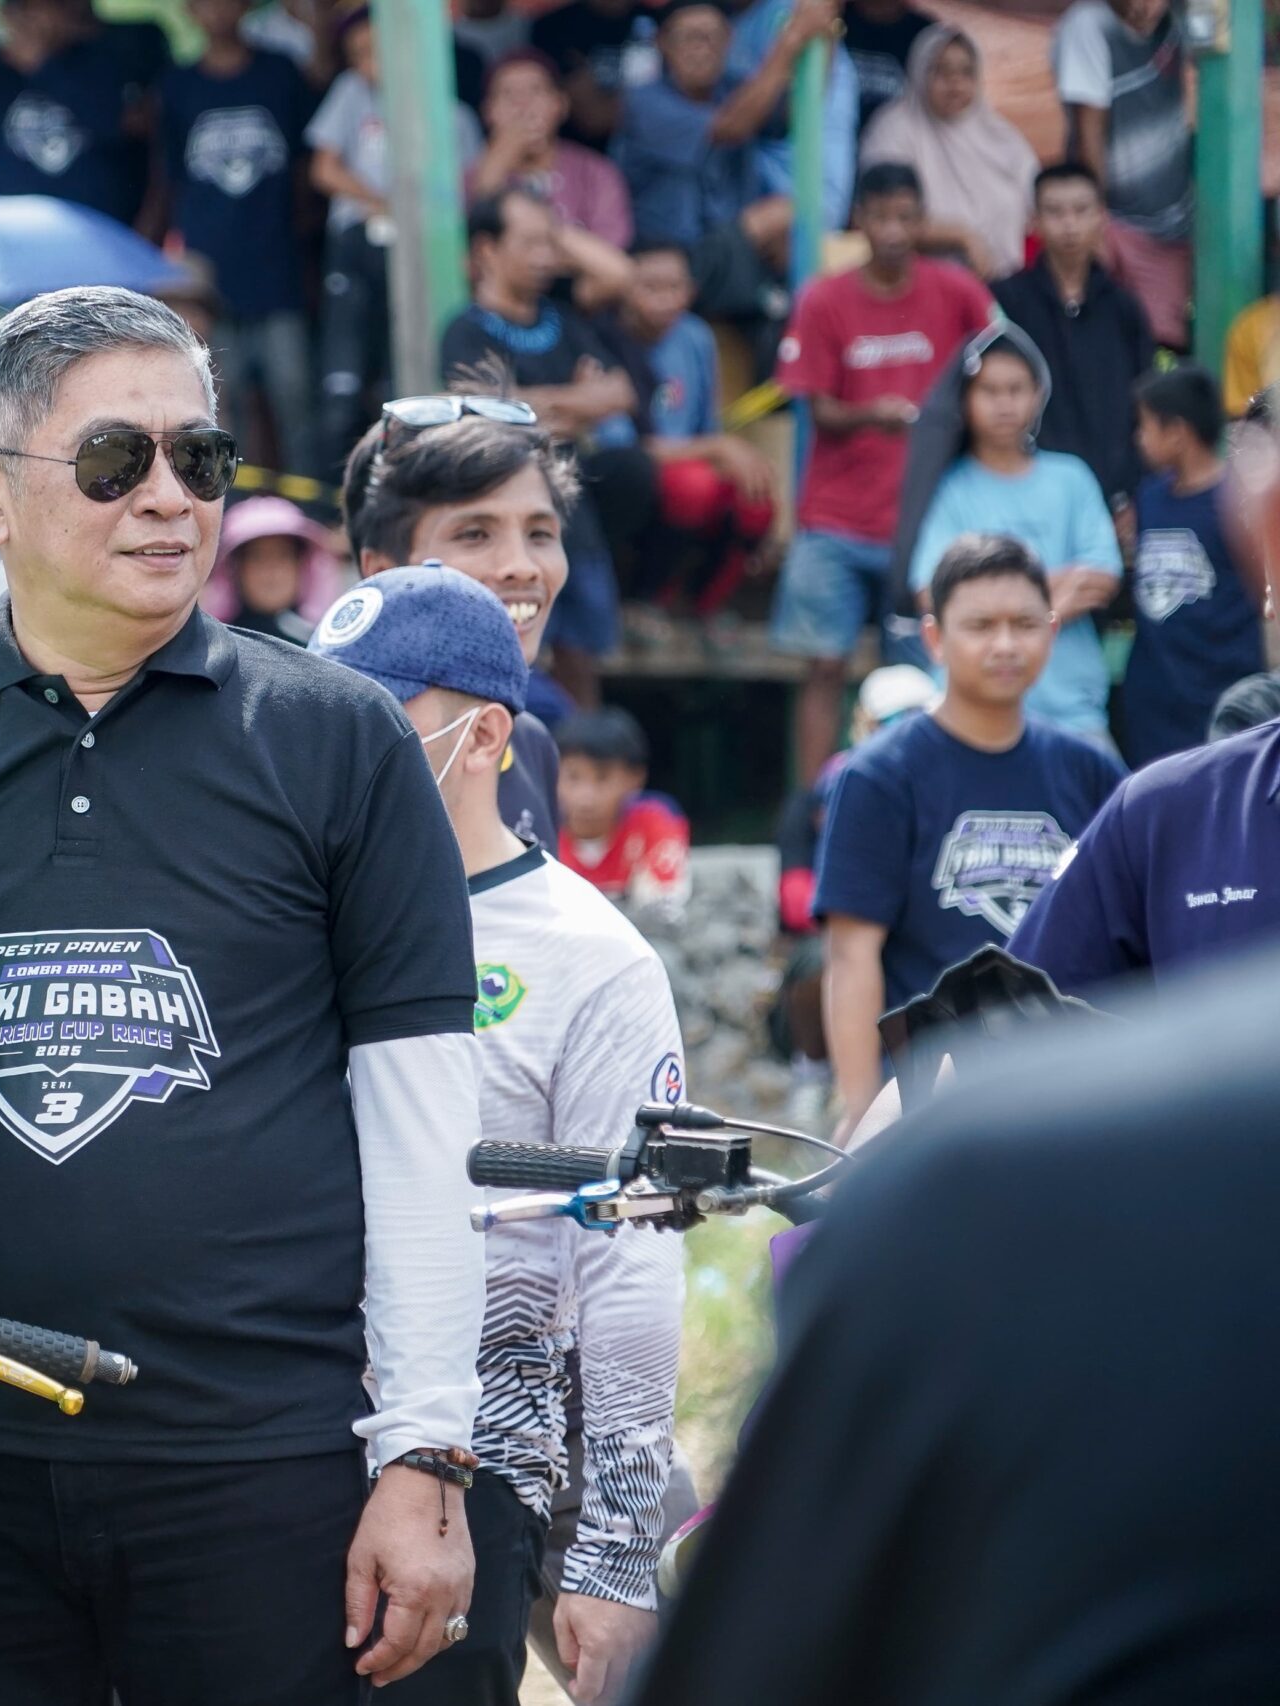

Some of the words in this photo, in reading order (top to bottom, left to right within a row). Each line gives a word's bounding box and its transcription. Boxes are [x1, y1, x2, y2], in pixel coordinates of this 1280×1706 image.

[64, 941, 141, 953] PANEN
[7, 965, 62, 978] LOMBA
[66, 964, 123, 975] BALAP
[44, 982, 190, 1028] GABAH
[60, 1021, 104, 1041] CUP
[112, 1023, 173, 1050] RACE
[35, 1045, 83, 1057] 2025
[34, 1093, 84, 1124] 3
